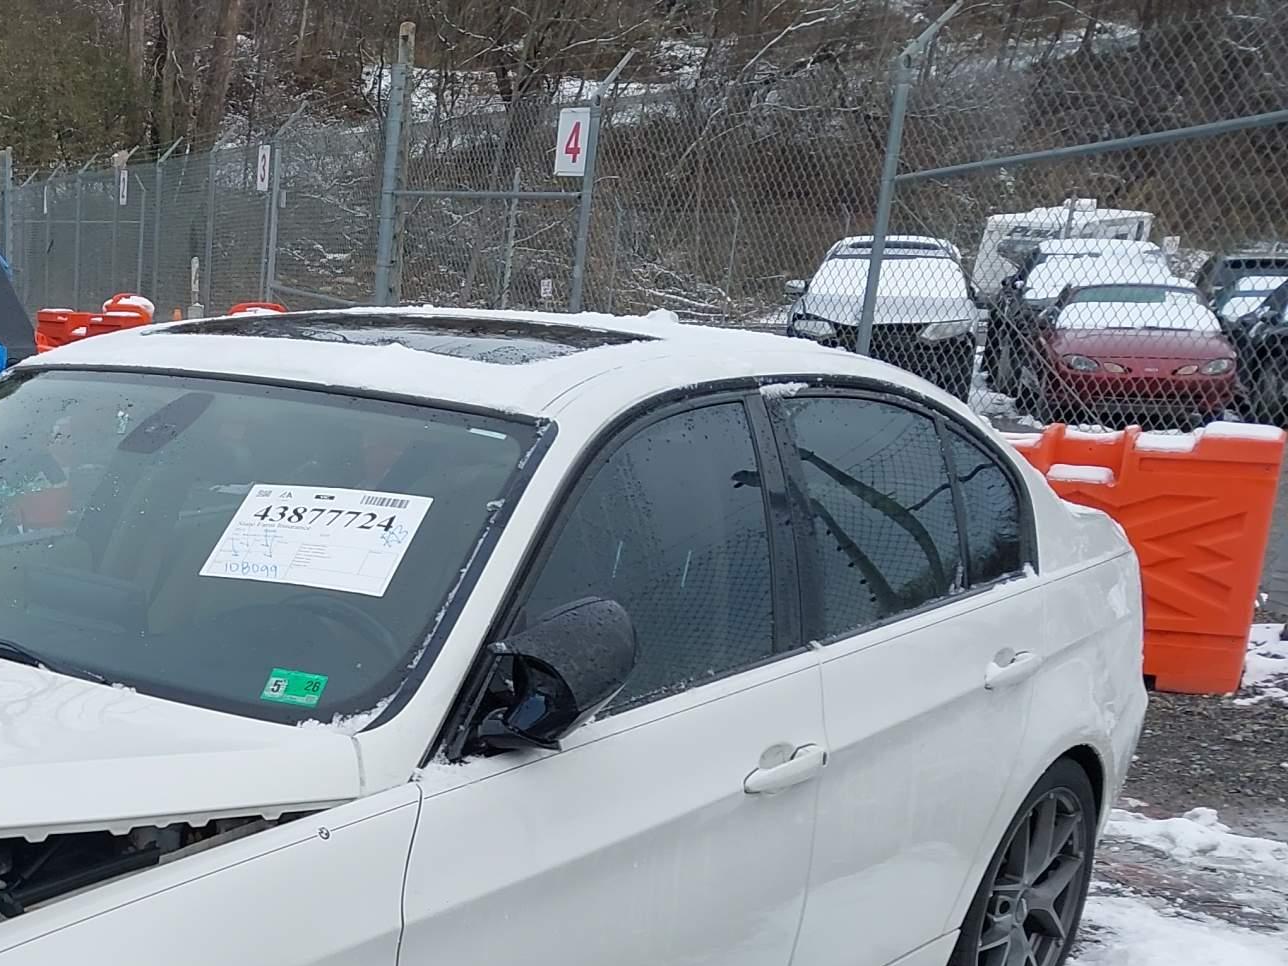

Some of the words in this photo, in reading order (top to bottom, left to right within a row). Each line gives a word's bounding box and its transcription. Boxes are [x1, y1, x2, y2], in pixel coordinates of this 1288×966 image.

[565, 121, 581, 163] 4
[253, 504, 397, 532] 43877724
[271, 679, 283, 693] 5
[304, 680, 321, 693] 26
